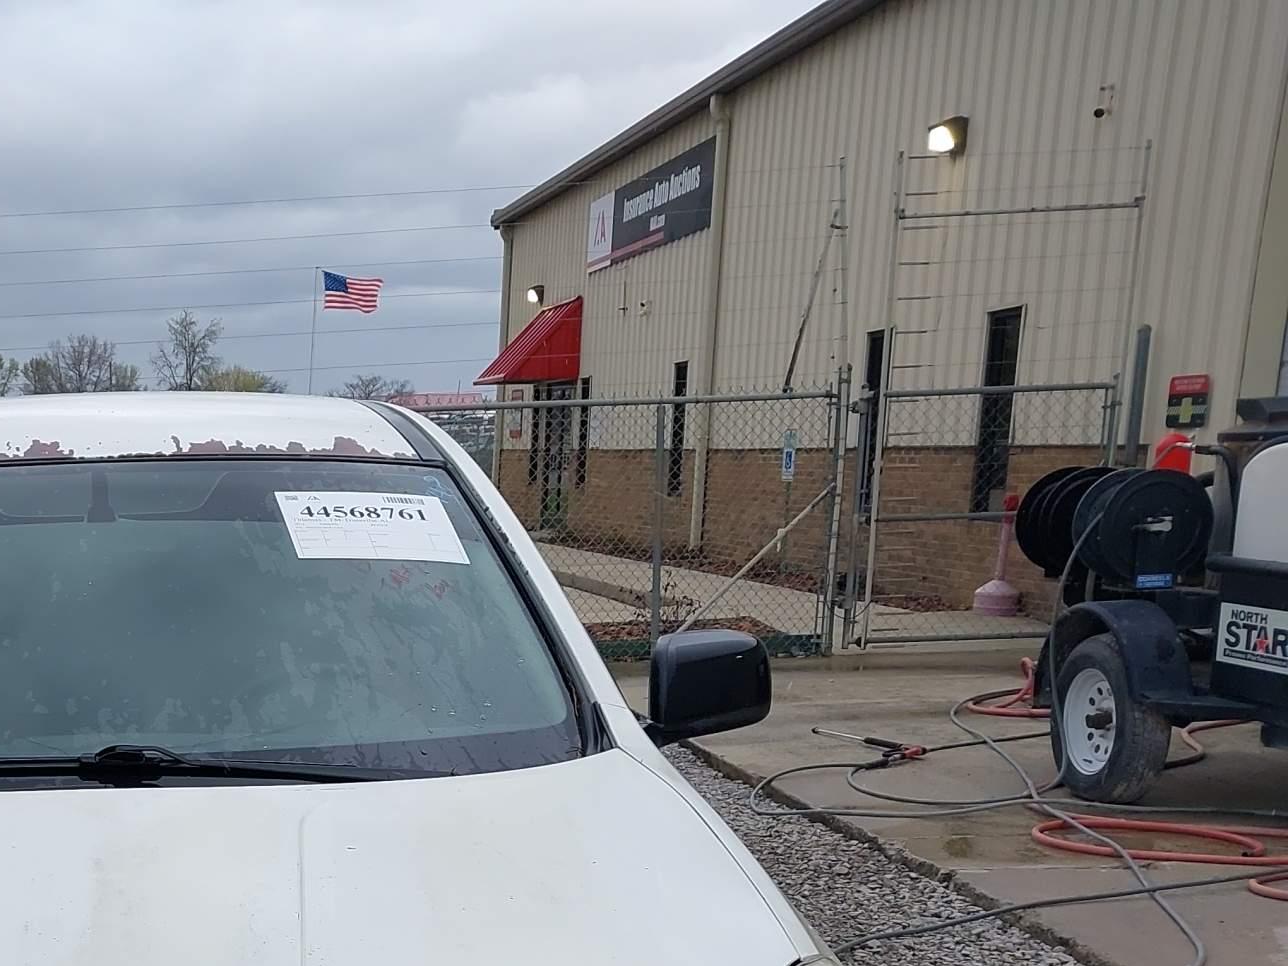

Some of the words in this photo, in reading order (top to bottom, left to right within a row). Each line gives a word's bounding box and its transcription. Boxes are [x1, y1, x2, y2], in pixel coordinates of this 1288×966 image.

[623, 189, 653, 222] Insurance
[654, 179, 669, 206] Auto
[669, 165, 700, 200] Auctions
[300, 505, 429, 522] 44568761
[1231, 609, 1269, 625] NORTH
[1225, 621, 1288, 657] STAR
